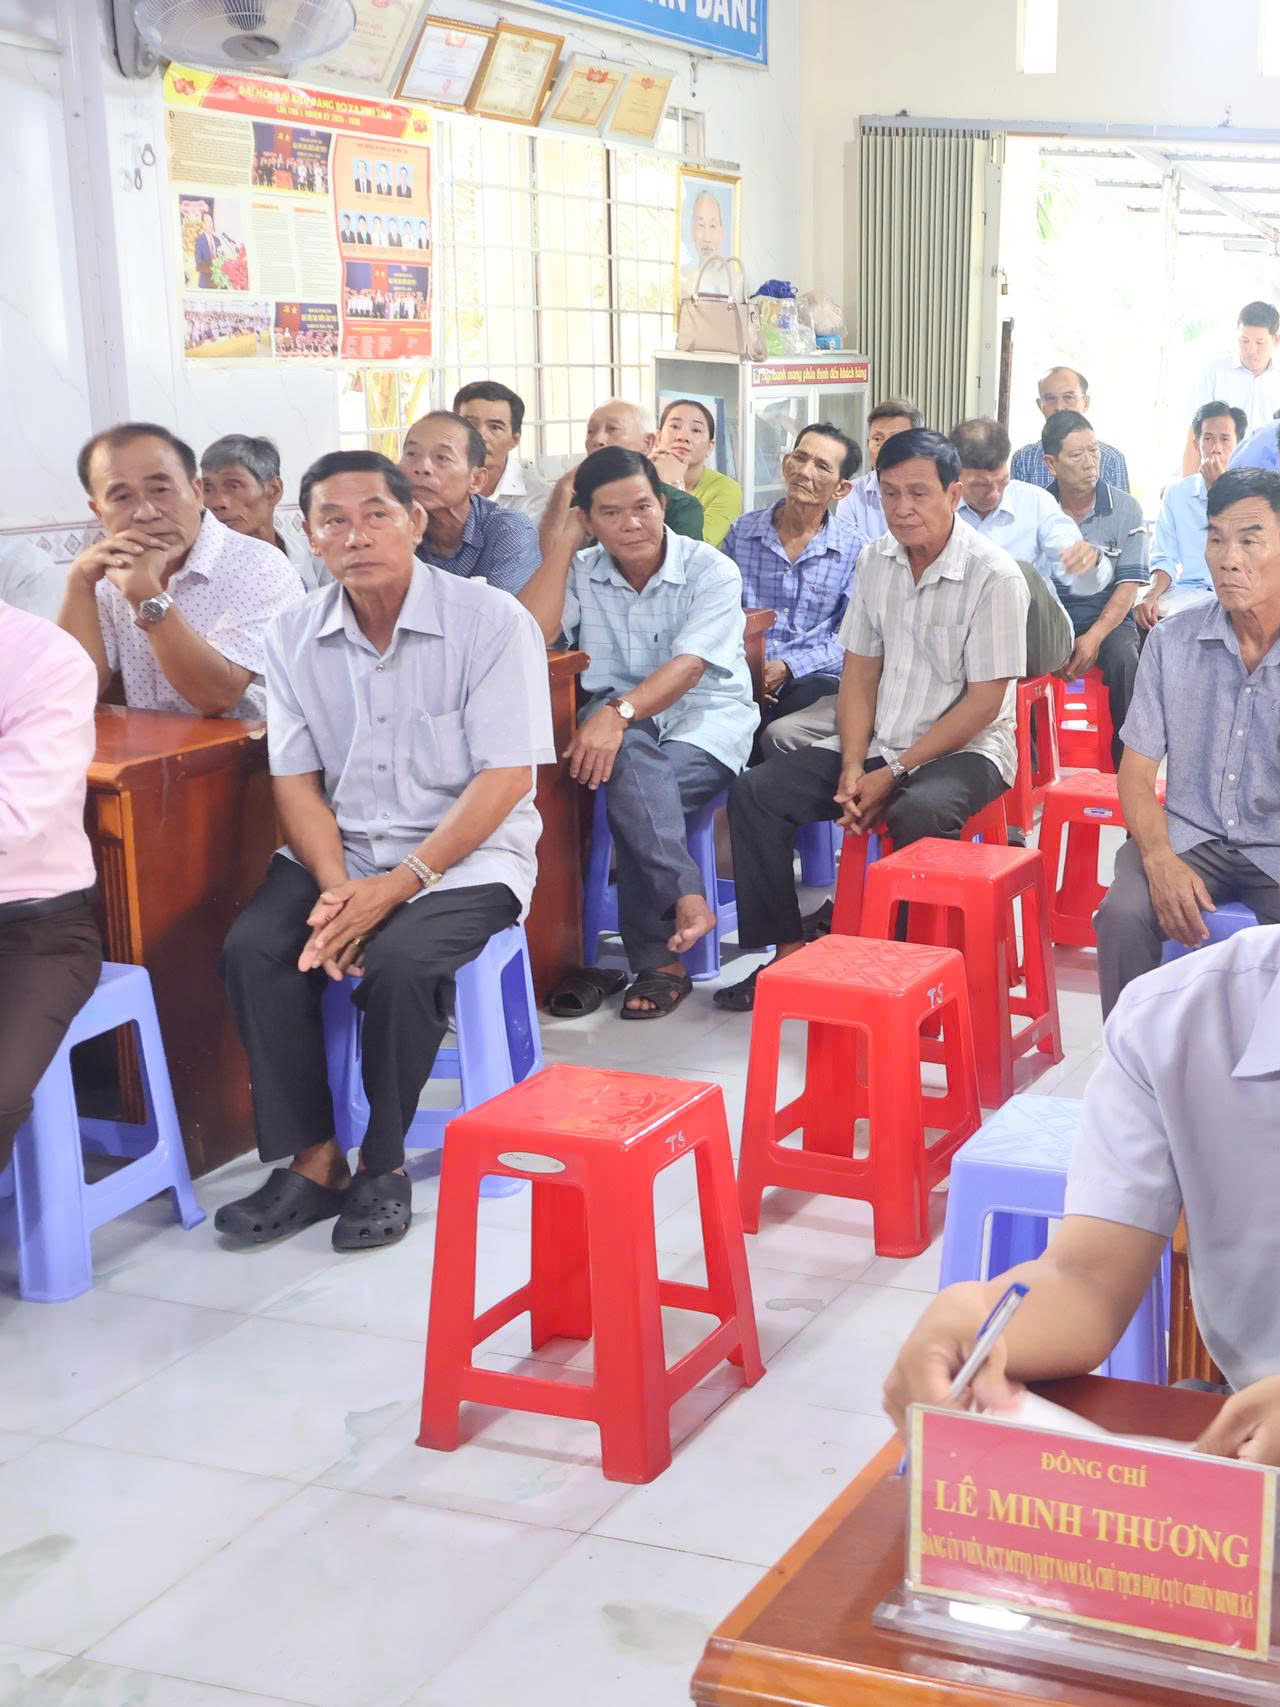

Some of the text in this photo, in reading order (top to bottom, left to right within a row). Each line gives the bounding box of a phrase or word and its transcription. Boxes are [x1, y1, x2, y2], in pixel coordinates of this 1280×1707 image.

[1040, 1449, 1148, 1488] ĐỒNG CHÍ
[935, 1475, 1249, 1569] LÊ MINH THƯƠNG
